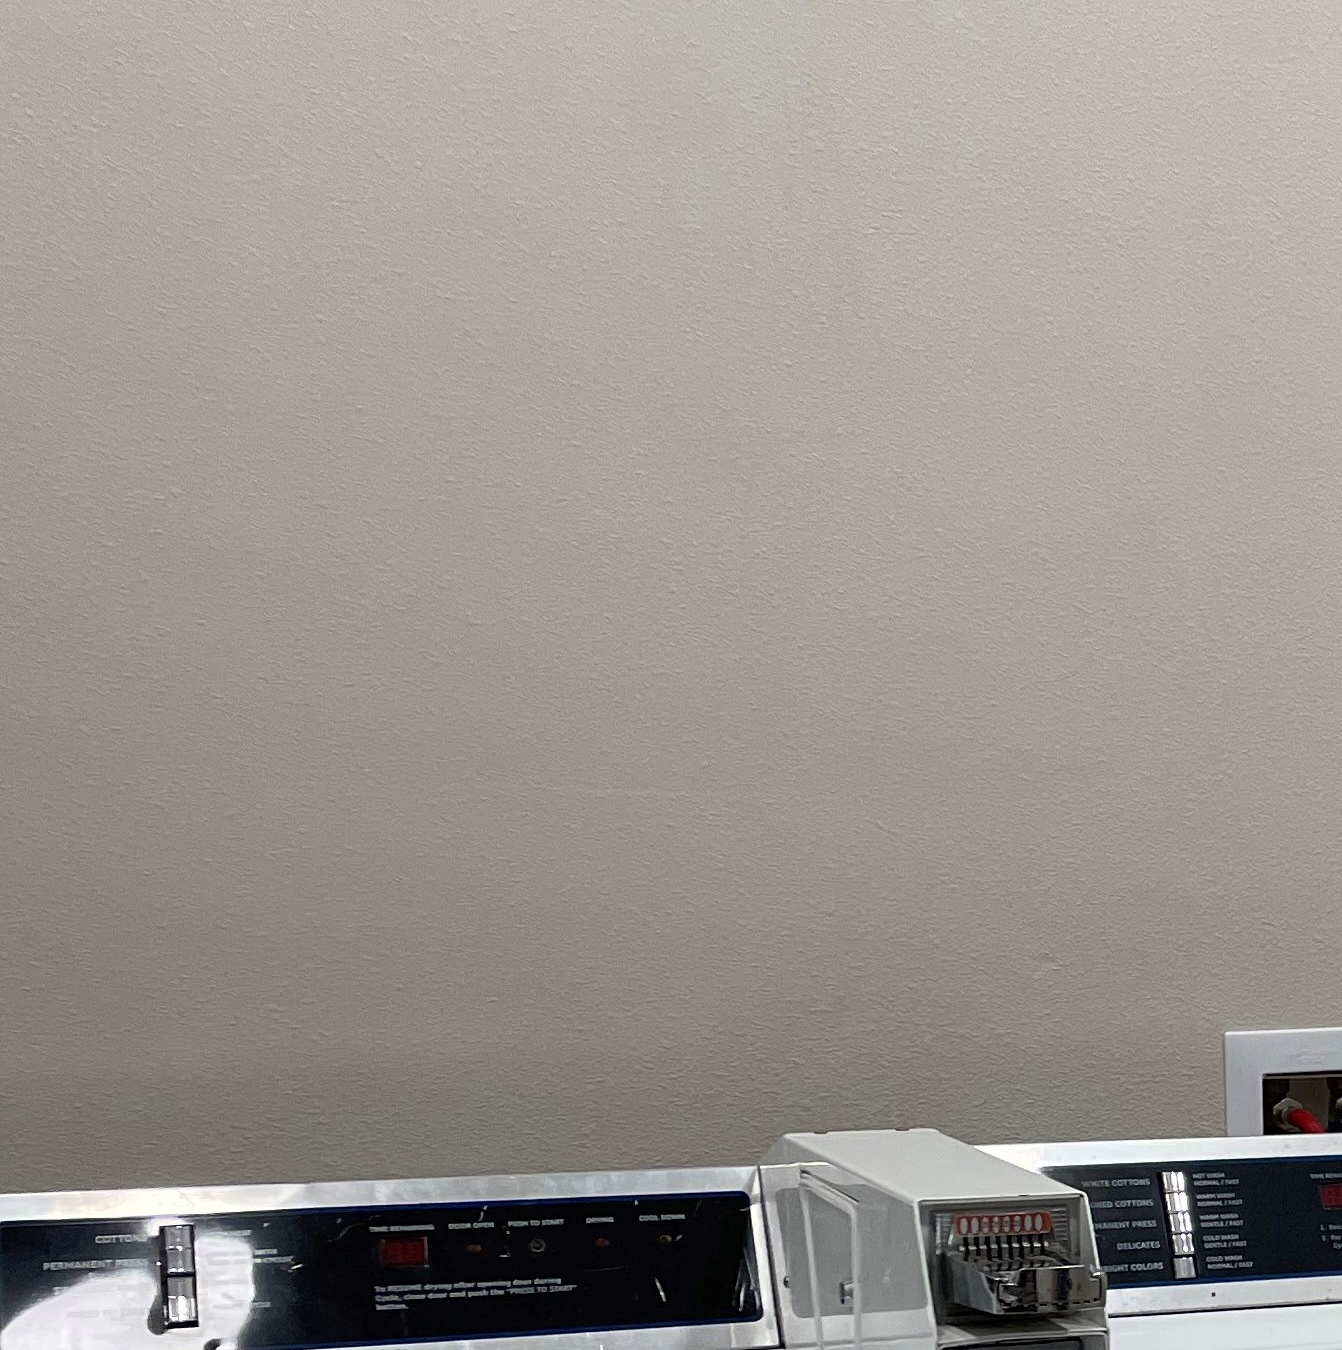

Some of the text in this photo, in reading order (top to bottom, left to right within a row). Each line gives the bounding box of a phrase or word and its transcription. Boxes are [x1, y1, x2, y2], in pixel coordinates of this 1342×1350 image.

[1112, 1178, 1150, 1187] COTTONS
[1115, 1199, 1154, 1207] COTTONS
[1117, 1241, 1160, 1250] DELICATES
[43, 1259, 115, 1271] PERMANENT
[1130, 1262, 1164, 1271] COLORS
